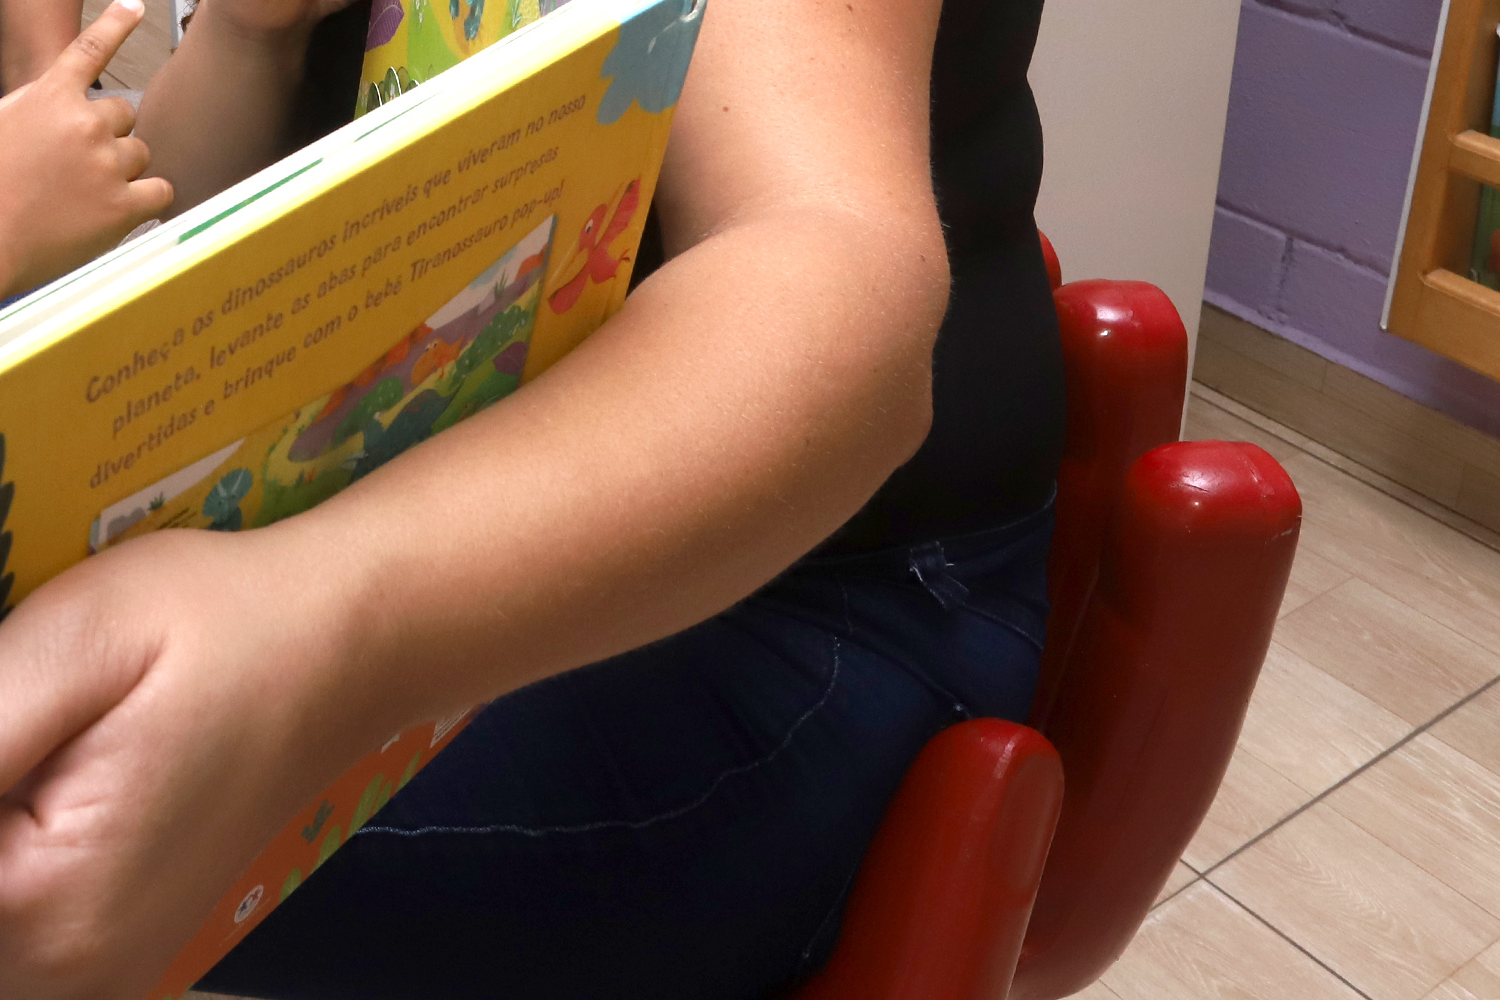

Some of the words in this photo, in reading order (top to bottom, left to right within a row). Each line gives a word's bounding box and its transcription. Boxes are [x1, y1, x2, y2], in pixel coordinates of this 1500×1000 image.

[86, 328, 185, 403] Conheça
[193, 310, 213, 337] os
[222, 231, 337, 315] dinossauros
[342, 184, 418, 243] incríveis
[423, 170, 452, 198] que
[457, 126, 521, 173] viveram
[525, 115, 544, 139] no
[548, 95, 586, 127] nosso
[90, 407, 198, 489] divertidas
[204, 399, 215, 417] e
[223, 350, 297, 402] brinque
[303, 320, 343, 350] com
[348, 305, 358, 322] o
[365, 274, 402, 311] bebê
[410, 216, 508, 283] Tiranossauro
[512, 180, 565, 233] pop-up!
[210, 308, 283, 369] levante
[291, 295, 310, 319] as
[317, 269, 356, 299] abas
[362, 237, 402, 276] para
[406, 188, 487, 247] encontrar
[493, 146, 559, 196] surpresas
